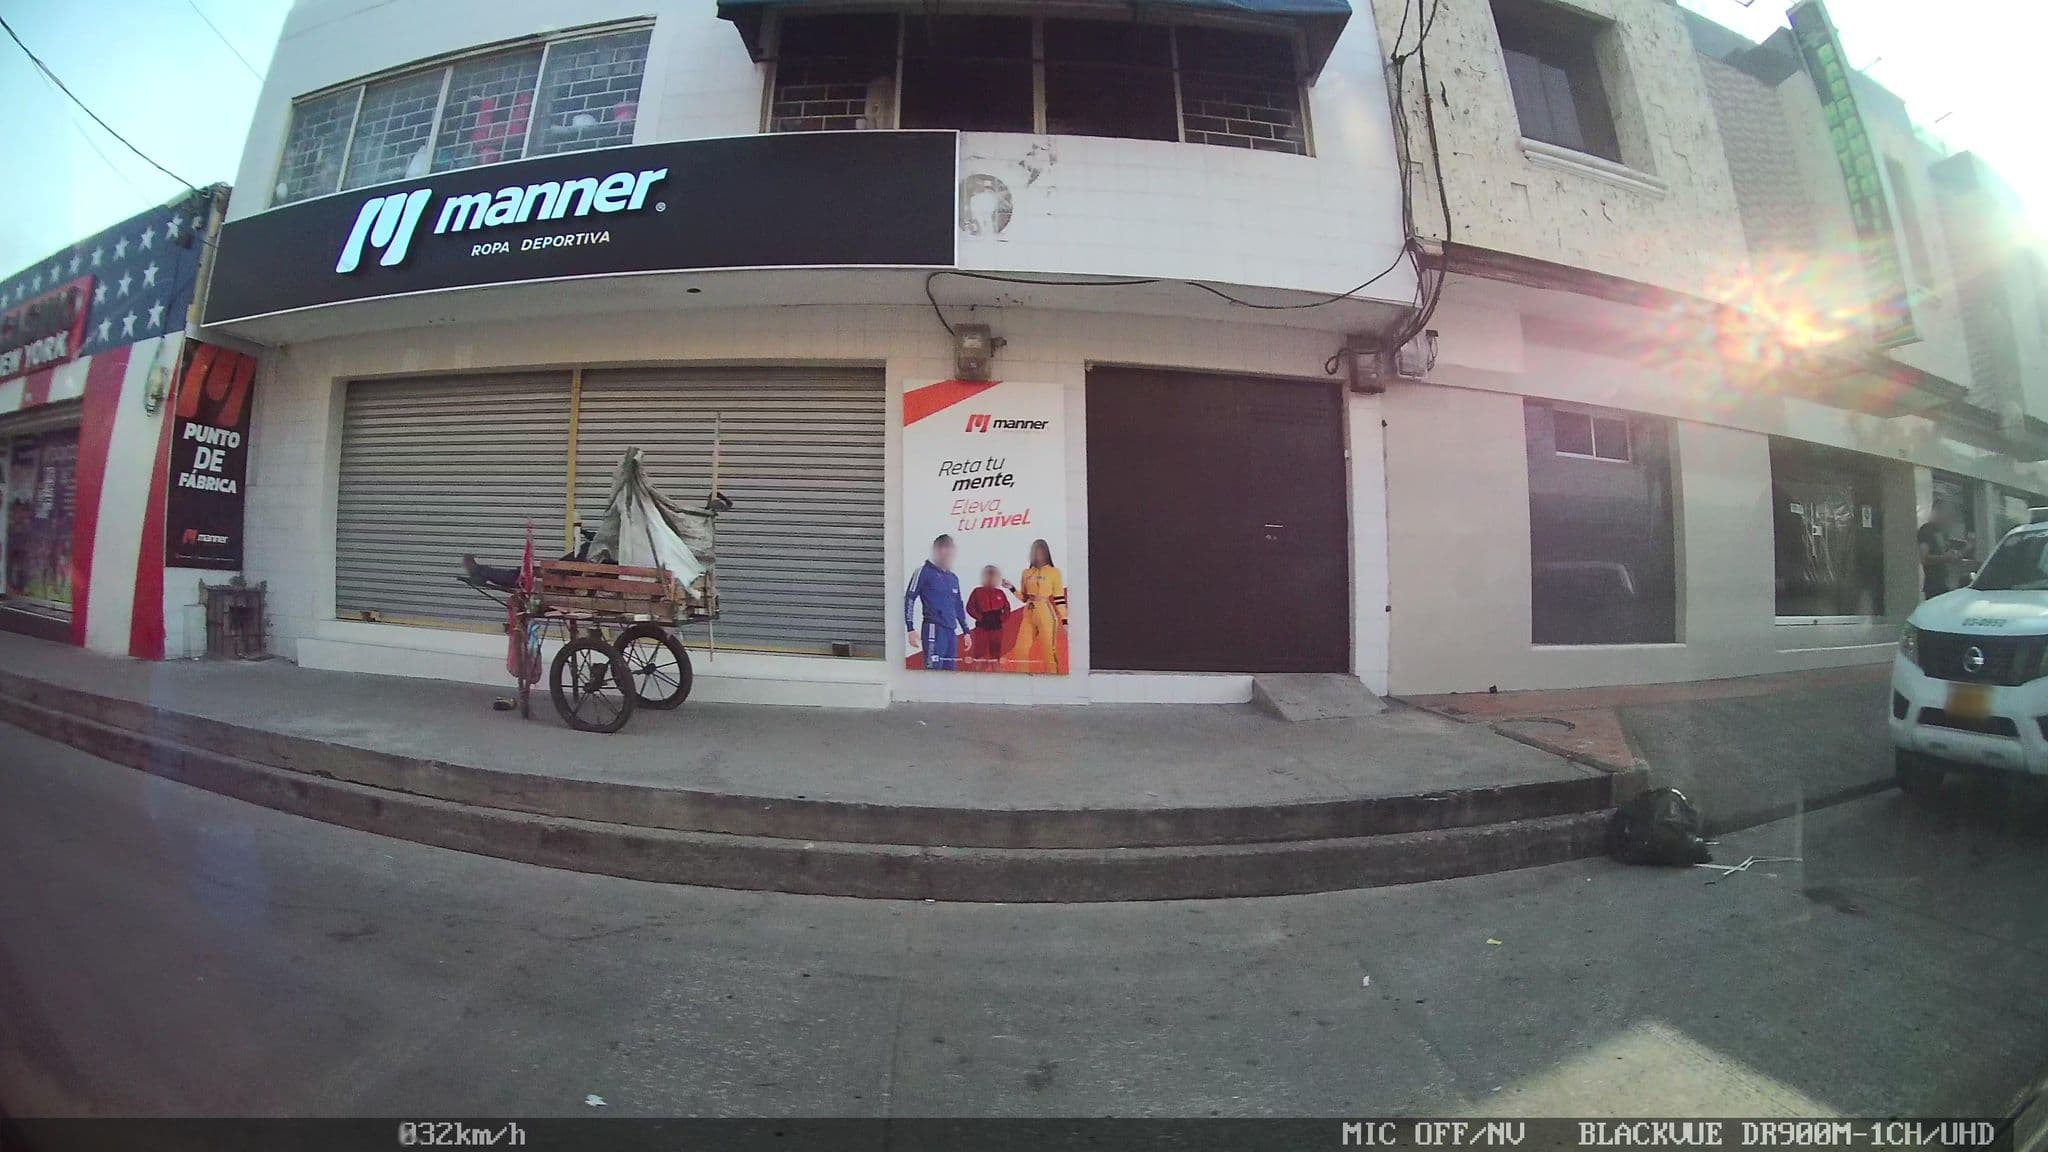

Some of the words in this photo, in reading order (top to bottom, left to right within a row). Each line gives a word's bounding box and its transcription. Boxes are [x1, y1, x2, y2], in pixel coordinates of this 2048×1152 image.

[433, 168, 668, 234] manner
[470, 241, 510, 257] ROPA
[521, 230, 611, 252] DEPORTIVA
[183, 422, 240, 448] PUNTO
[993, 419, 1049, 430] manner
[193, 446, 226, 473] DE
[938, 459, 982, 477] Reta
[985, 456, 1005, 471] tu
[178, 470, 237, 494] FÁBRICA
[951, 472, 1015, 492] mente,
[950, 499, 1001, 516] Eleva
[958, 517, 977, 531] tu
[196, 533, 229, 544] manner
